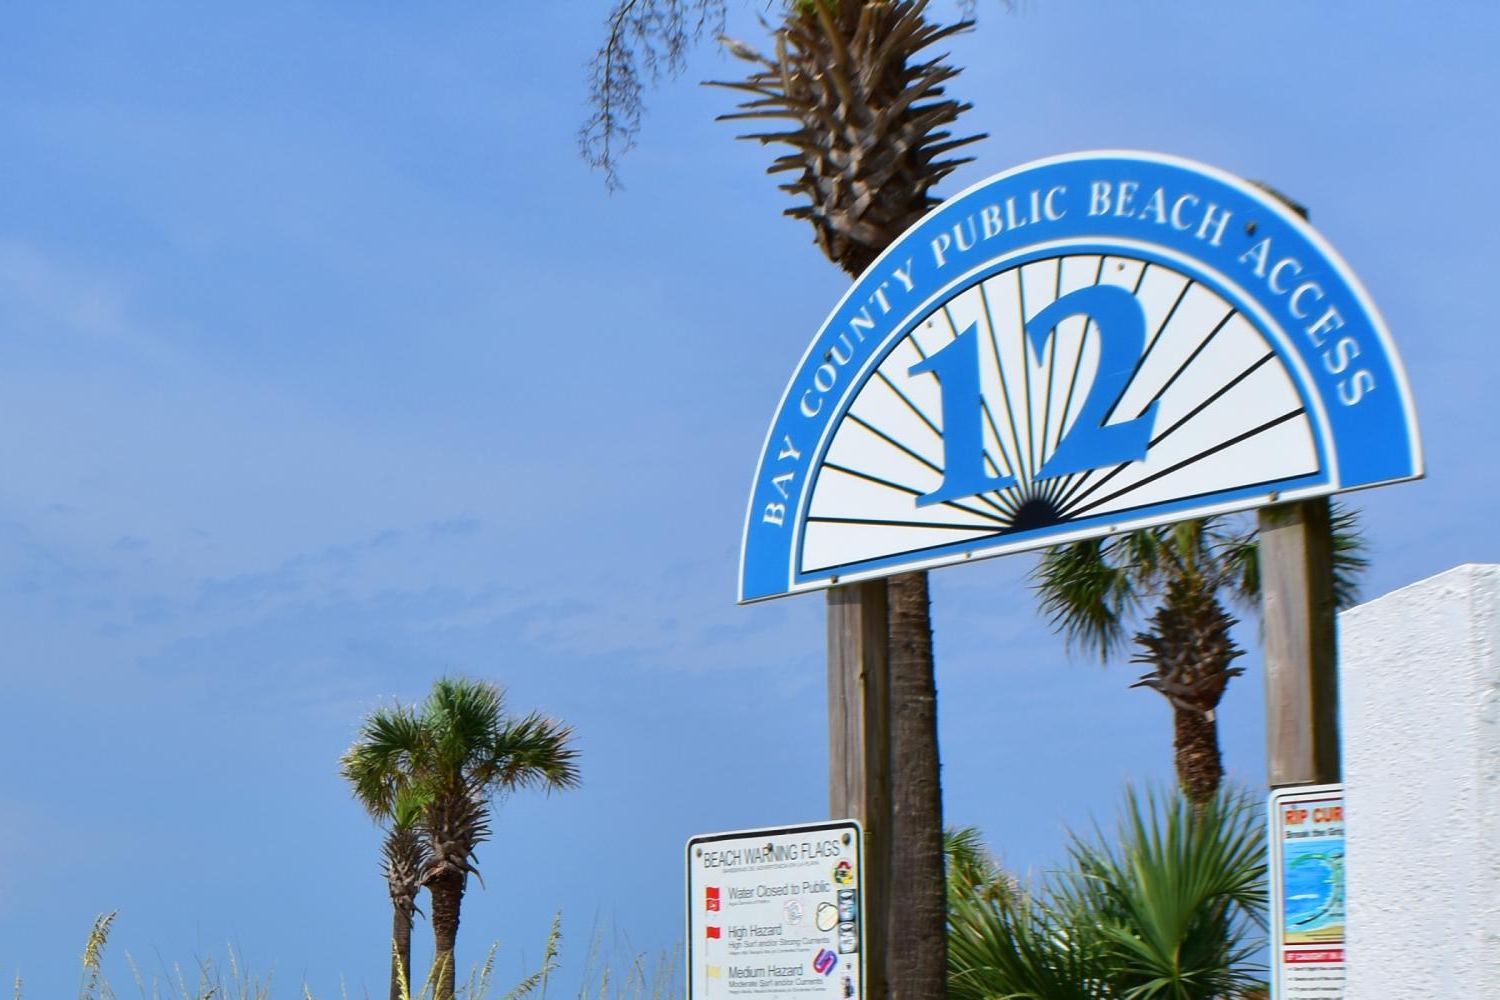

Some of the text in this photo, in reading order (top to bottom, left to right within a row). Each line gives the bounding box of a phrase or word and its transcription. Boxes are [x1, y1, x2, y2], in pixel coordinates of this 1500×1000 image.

[763, 181, 1376, 527] BAY COUNTY PUBLIC BEACH ACCESS
[908, 284, 1161, 508] 12
[1284, 808, 1308, 825] RIP
[704, 852, 741, 868] BEACH
[744, 844, 798, 865] WARNING
[801, 840, 840, 859] FLAGS
[728, 880, 830, 900] Water Closed to Public
[728, 924, 782, 940] High Hazard
[728, 964, 803, 979] Medium Hazard
